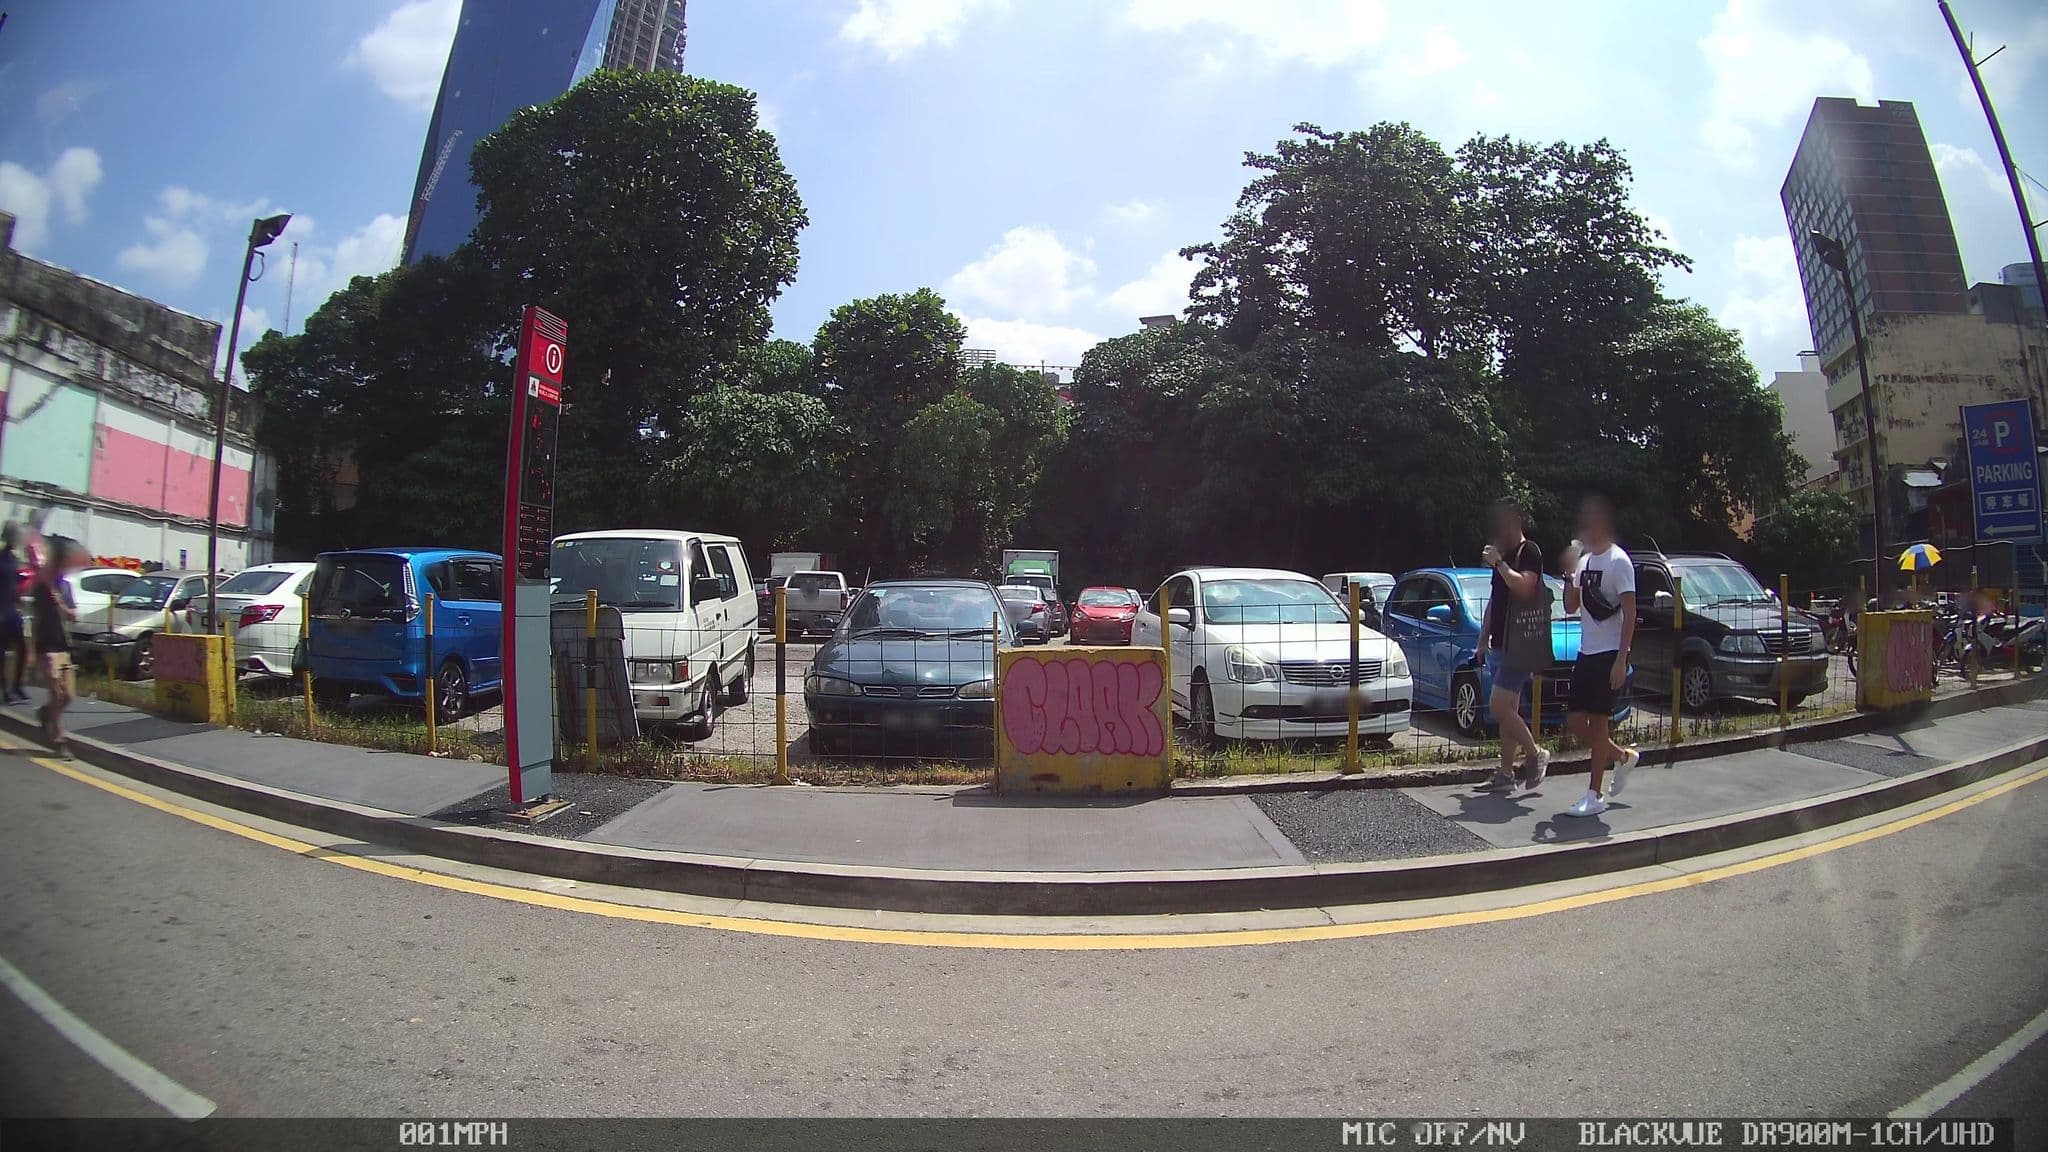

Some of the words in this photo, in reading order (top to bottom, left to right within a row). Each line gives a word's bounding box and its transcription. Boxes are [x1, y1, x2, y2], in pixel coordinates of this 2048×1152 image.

[1972, 428, 1988, 440] 24
[1993, 420, 2010, 448] P
[1976, 461, 2033, 484] PARKING
